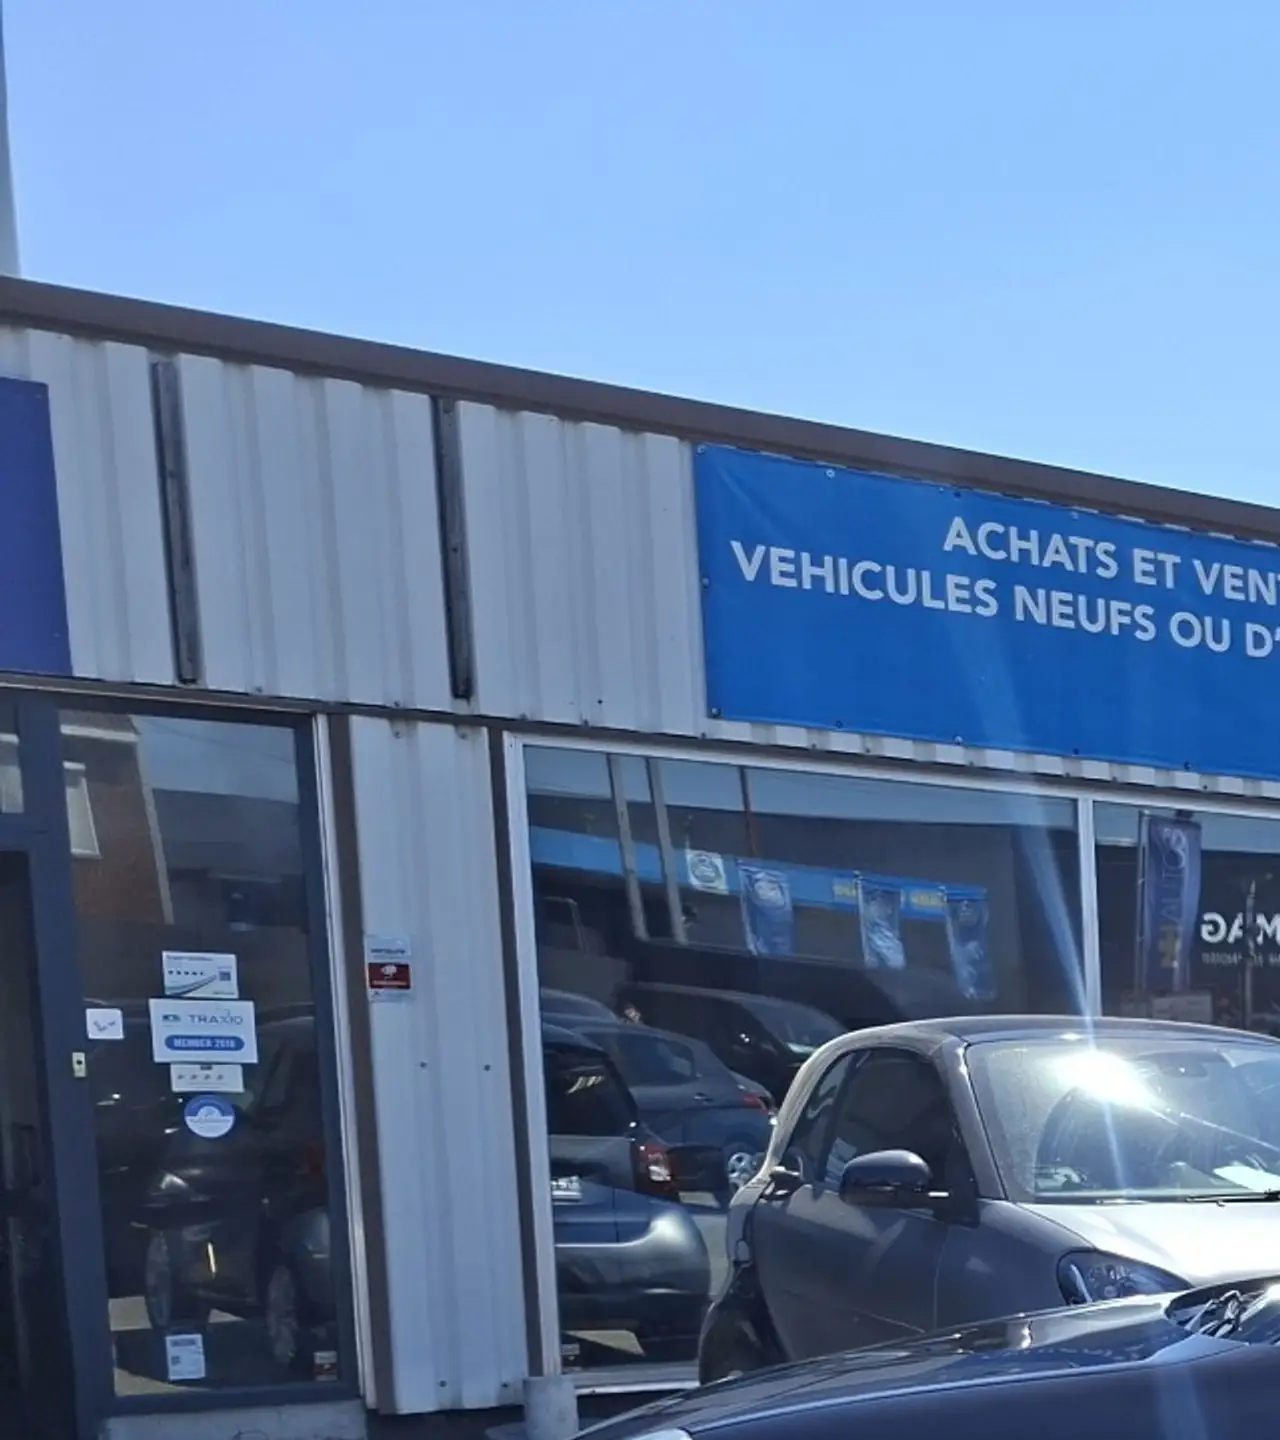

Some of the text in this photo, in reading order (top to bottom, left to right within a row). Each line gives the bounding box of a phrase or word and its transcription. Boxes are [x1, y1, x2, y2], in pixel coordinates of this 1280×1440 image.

[731, 541, 997, 616] VEHICULES
[1015, 586, 1155, 641] NEUFS
[1170, 612, 1230, 651] OU
[944, 517, 1117, 577] ACHATS
[1133, 548, 1181, 587] ET
